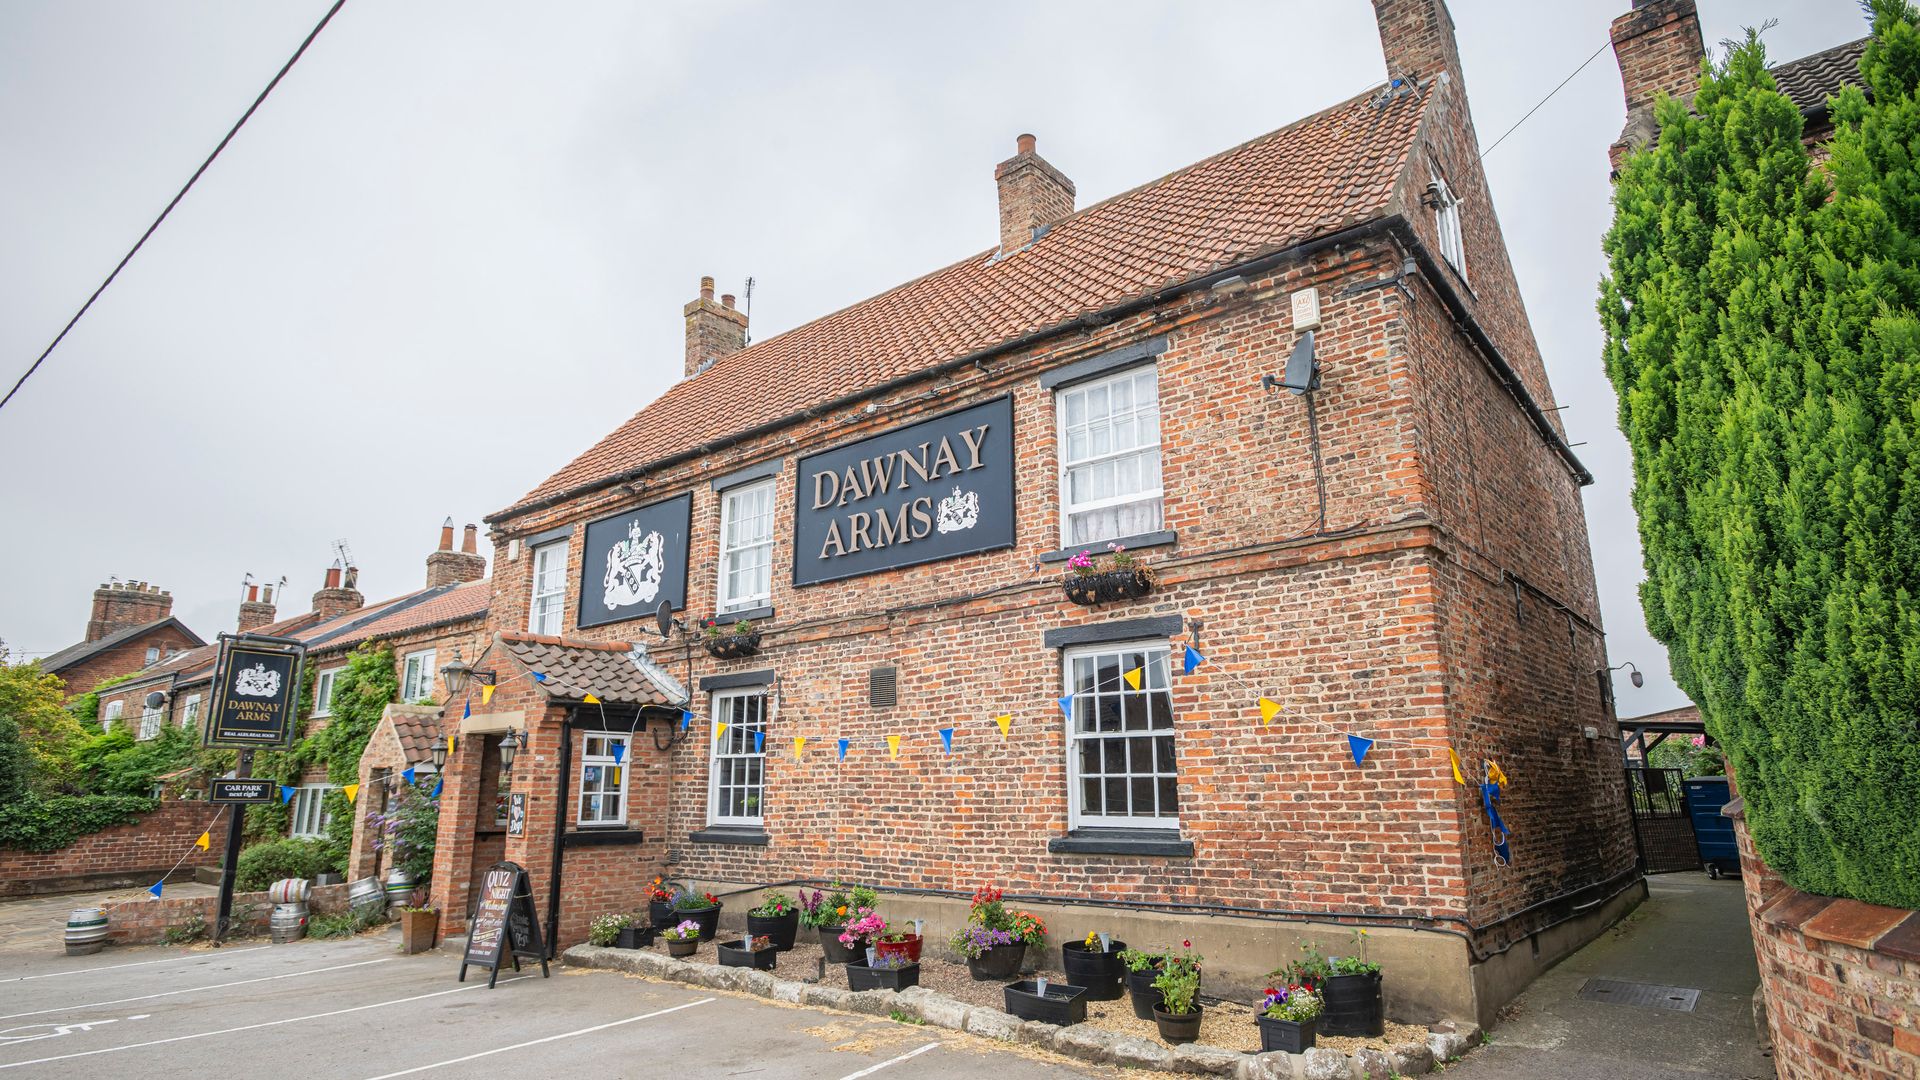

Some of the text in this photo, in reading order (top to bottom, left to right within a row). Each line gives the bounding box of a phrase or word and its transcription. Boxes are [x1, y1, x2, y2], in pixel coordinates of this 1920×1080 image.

[812, 424, 989, 510] DAWNAY
[819, 496, 932, 559] ARMS
[228, 700, 281, 713] DAWNAY
[235, 711, 271, 722] ARMS
[487, 871, 511, 892] QUIZ
[491, 888, 511, 899] NIGHT
